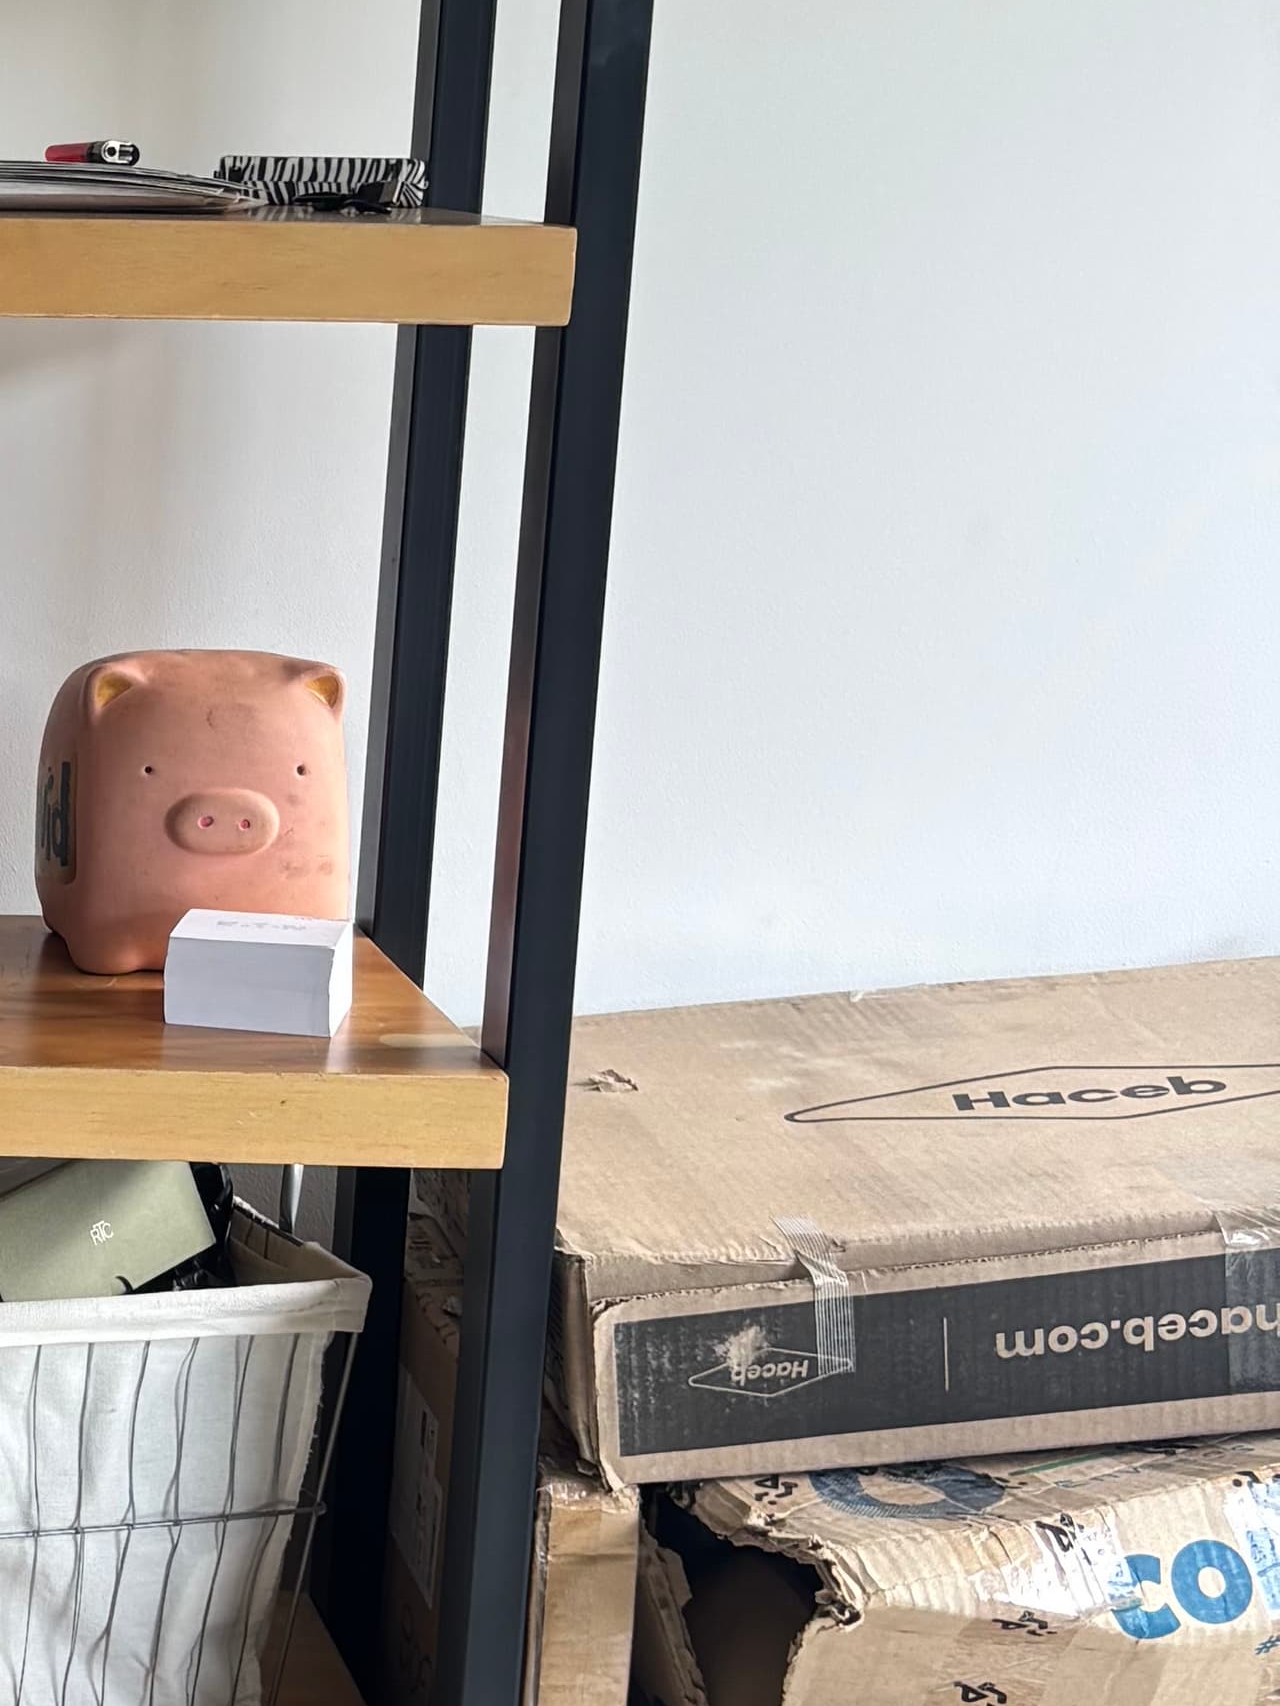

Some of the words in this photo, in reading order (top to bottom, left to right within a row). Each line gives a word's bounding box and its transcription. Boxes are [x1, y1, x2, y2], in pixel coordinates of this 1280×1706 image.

[952, 1076, 1226, 1111] Haceb
[995, 1303, 1280, 1359] haceb.com
[730, 1360, 809, 1387] Haceb
